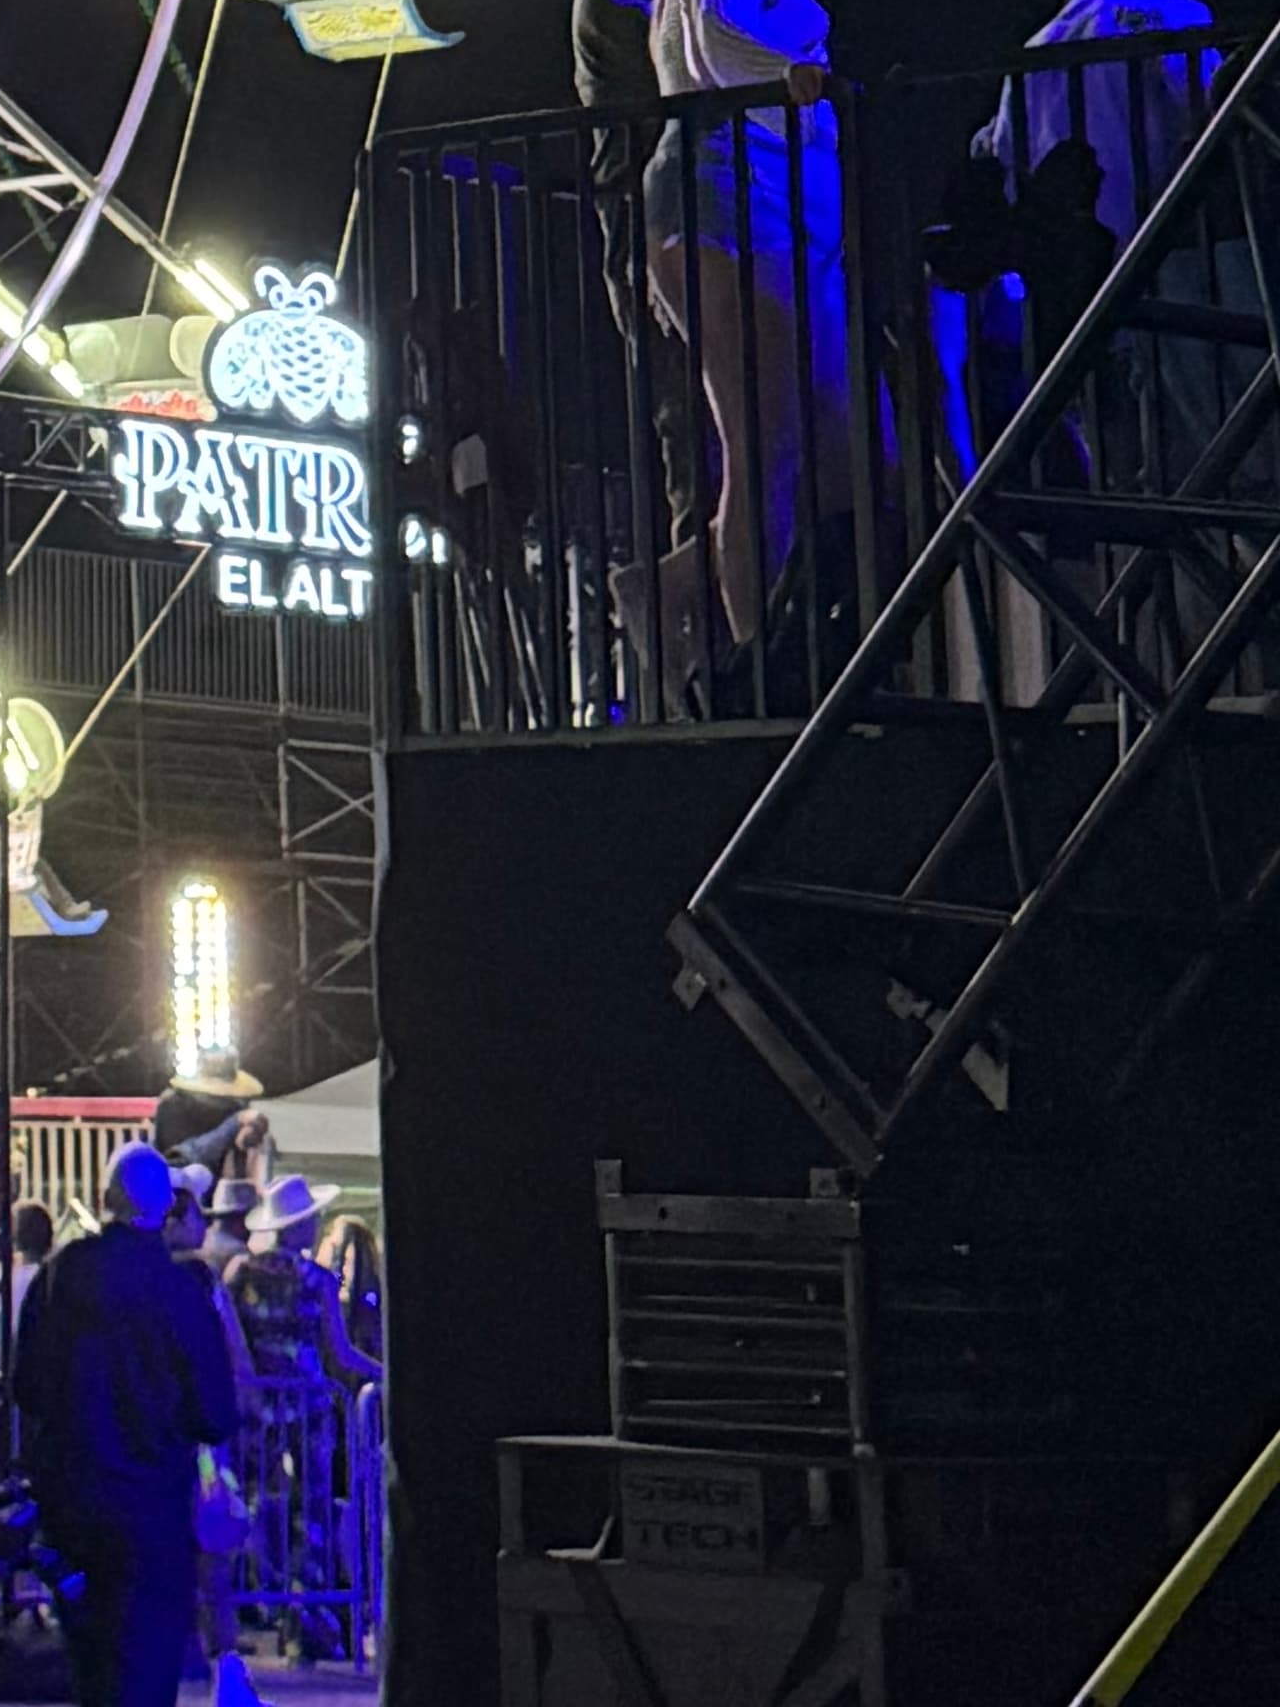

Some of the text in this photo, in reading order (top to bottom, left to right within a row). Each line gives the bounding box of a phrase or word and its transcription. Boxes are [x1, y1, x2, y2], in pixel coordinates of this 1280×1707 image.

[115, 420, 372, 559] PATR
[219, 555, 373, 618] EL ALT
